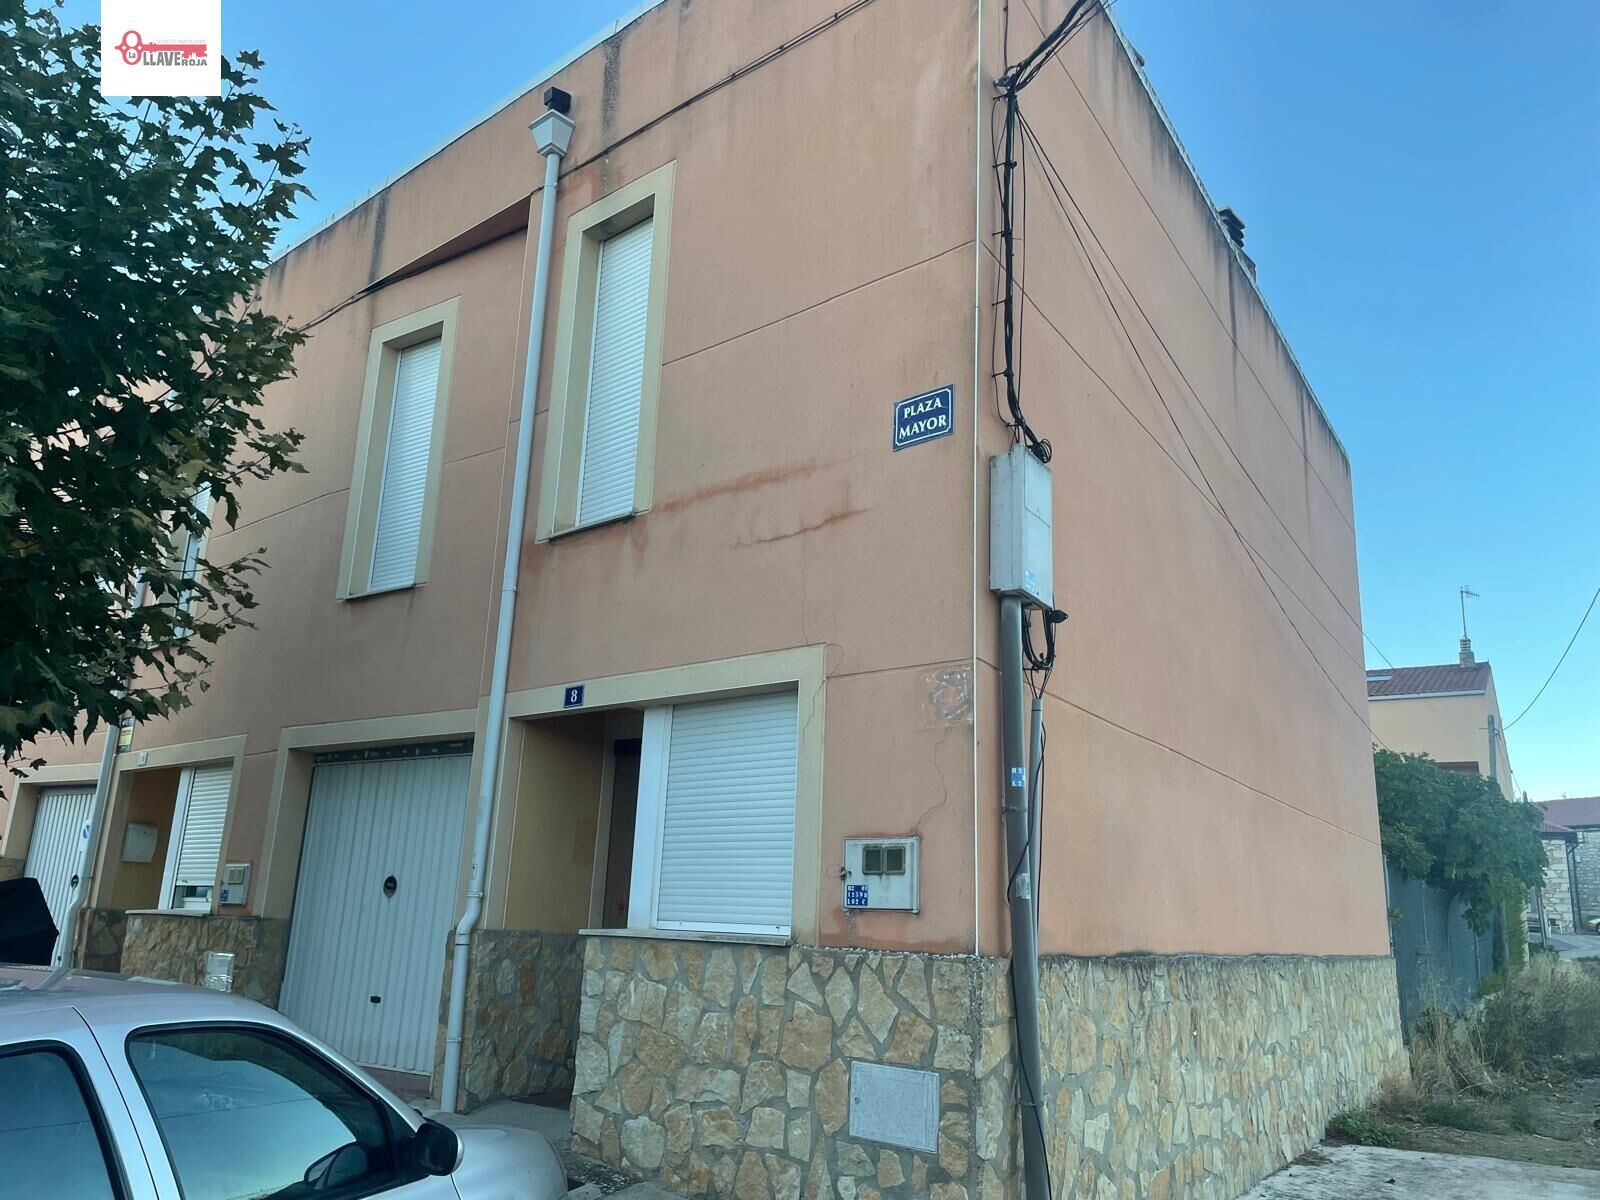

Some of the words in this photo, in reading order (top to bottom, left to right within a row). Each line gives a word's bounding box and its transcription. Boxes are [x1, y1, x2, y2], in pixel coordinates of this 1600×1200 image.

[903, 397, 942, 419] PLAZA
[899, 414, 947, 439] MAYOR
[570, 689, 578, 703] 8
